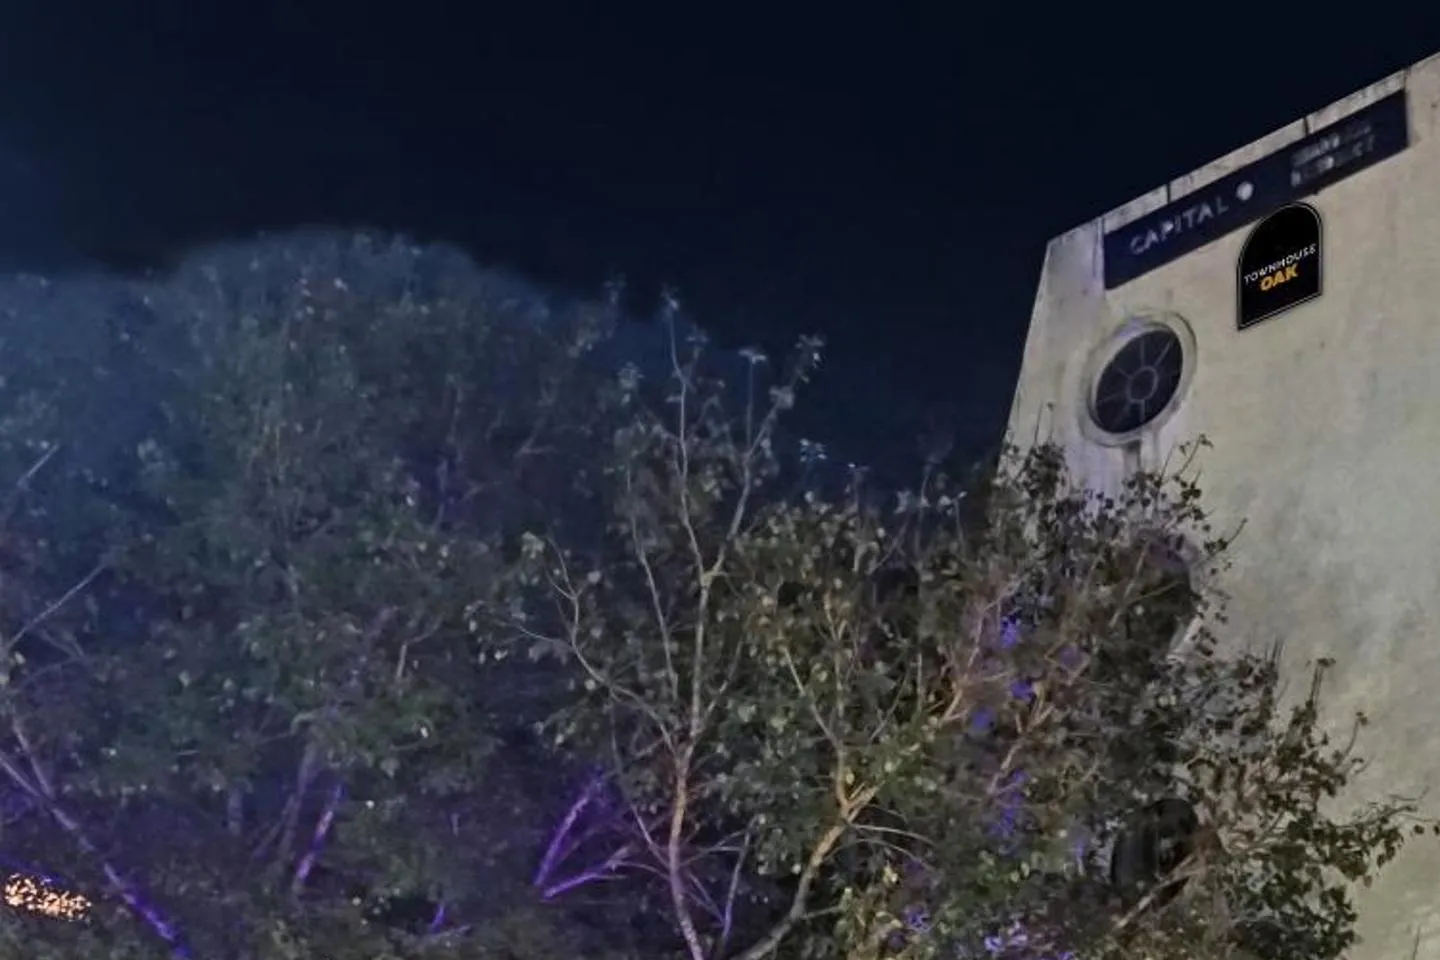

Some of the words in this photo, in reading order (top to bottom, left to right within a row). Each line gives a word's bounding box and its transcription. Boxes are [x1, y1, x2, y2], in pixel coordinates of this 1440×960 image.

[1130, 198, 1229, 254] CAPITAL
[1244, 243, 1317, 284] TOWNHOUSE
[1261, 263, 1299, 291] OAK
